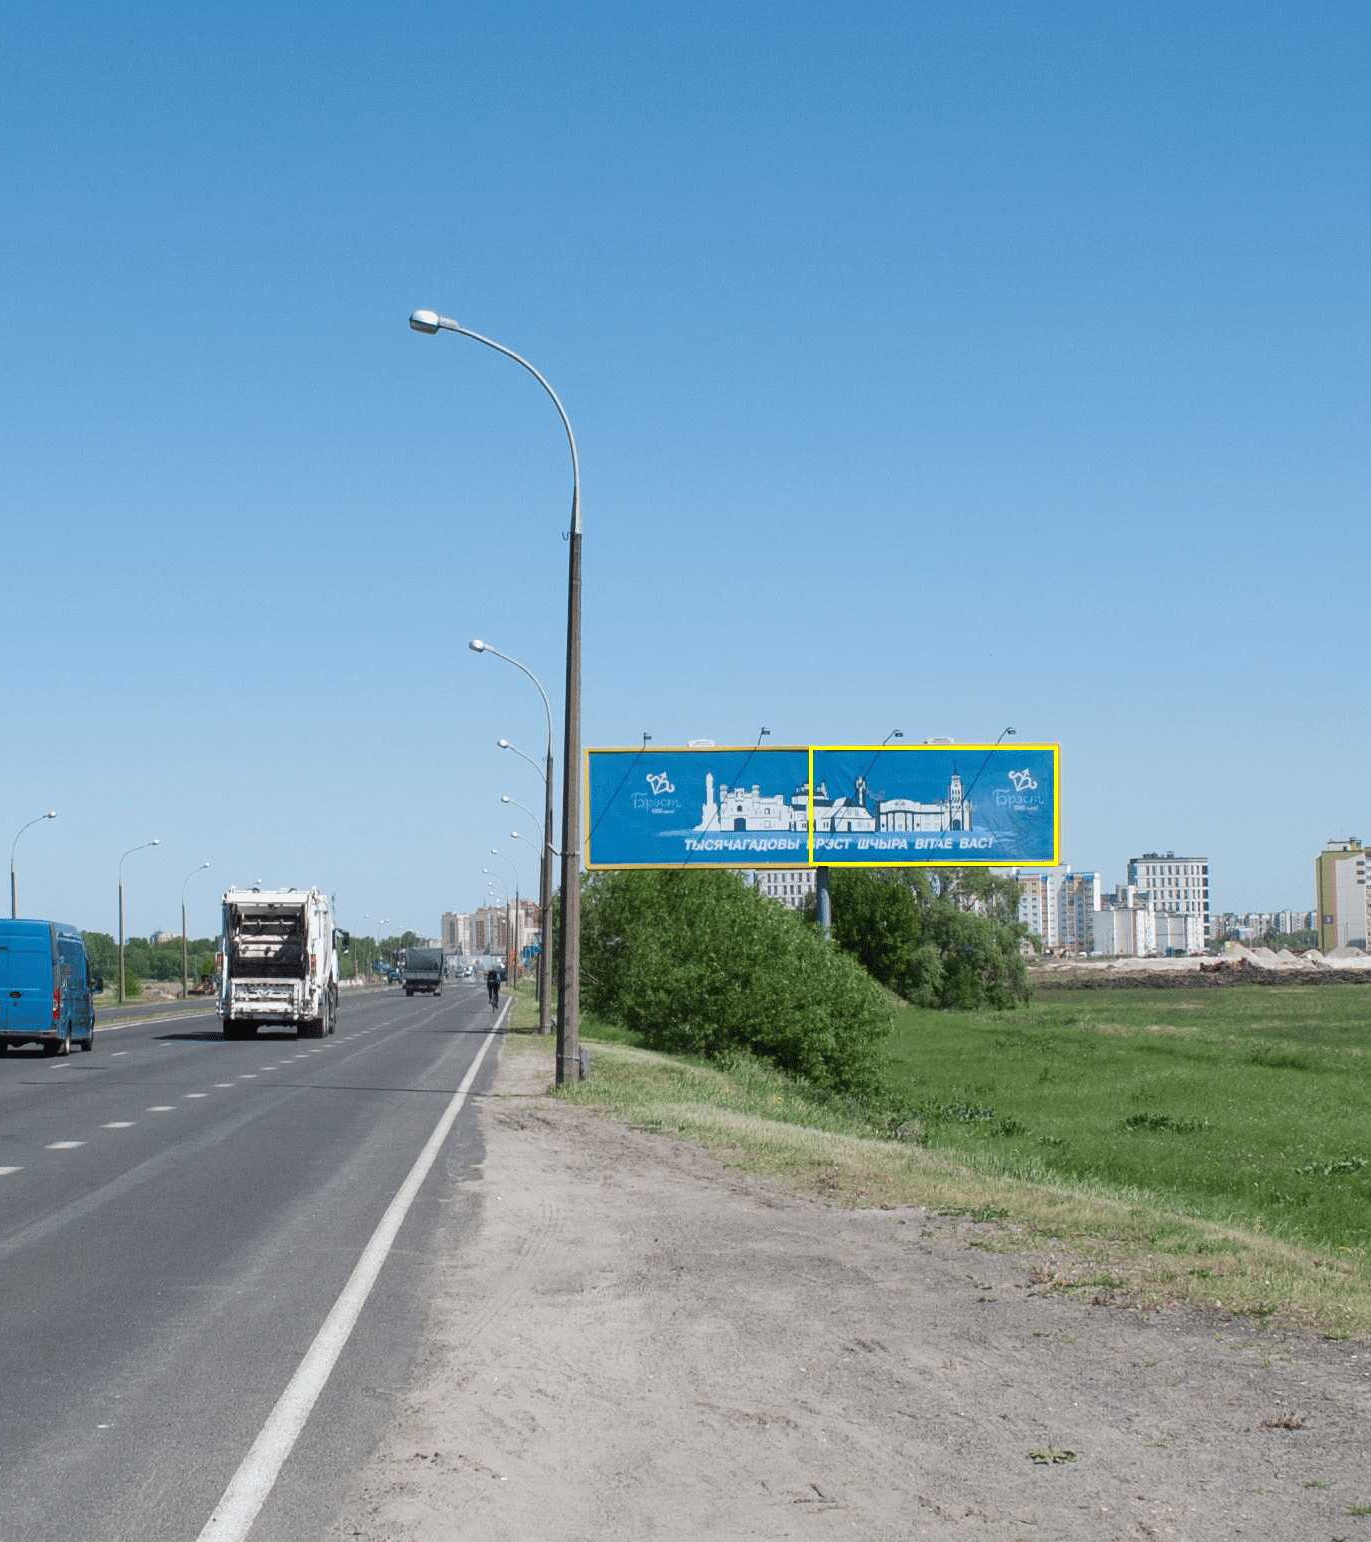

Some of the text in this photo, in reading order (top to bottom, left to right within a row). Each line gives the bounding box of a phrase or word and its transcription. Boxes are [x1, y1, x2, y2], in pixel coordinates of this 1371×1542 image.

[684, 836, 993, 851] ТЫСЯЧАГАДОВЫ БРЭСТ ШЧЫРА ВІТАЕ ВАС!
